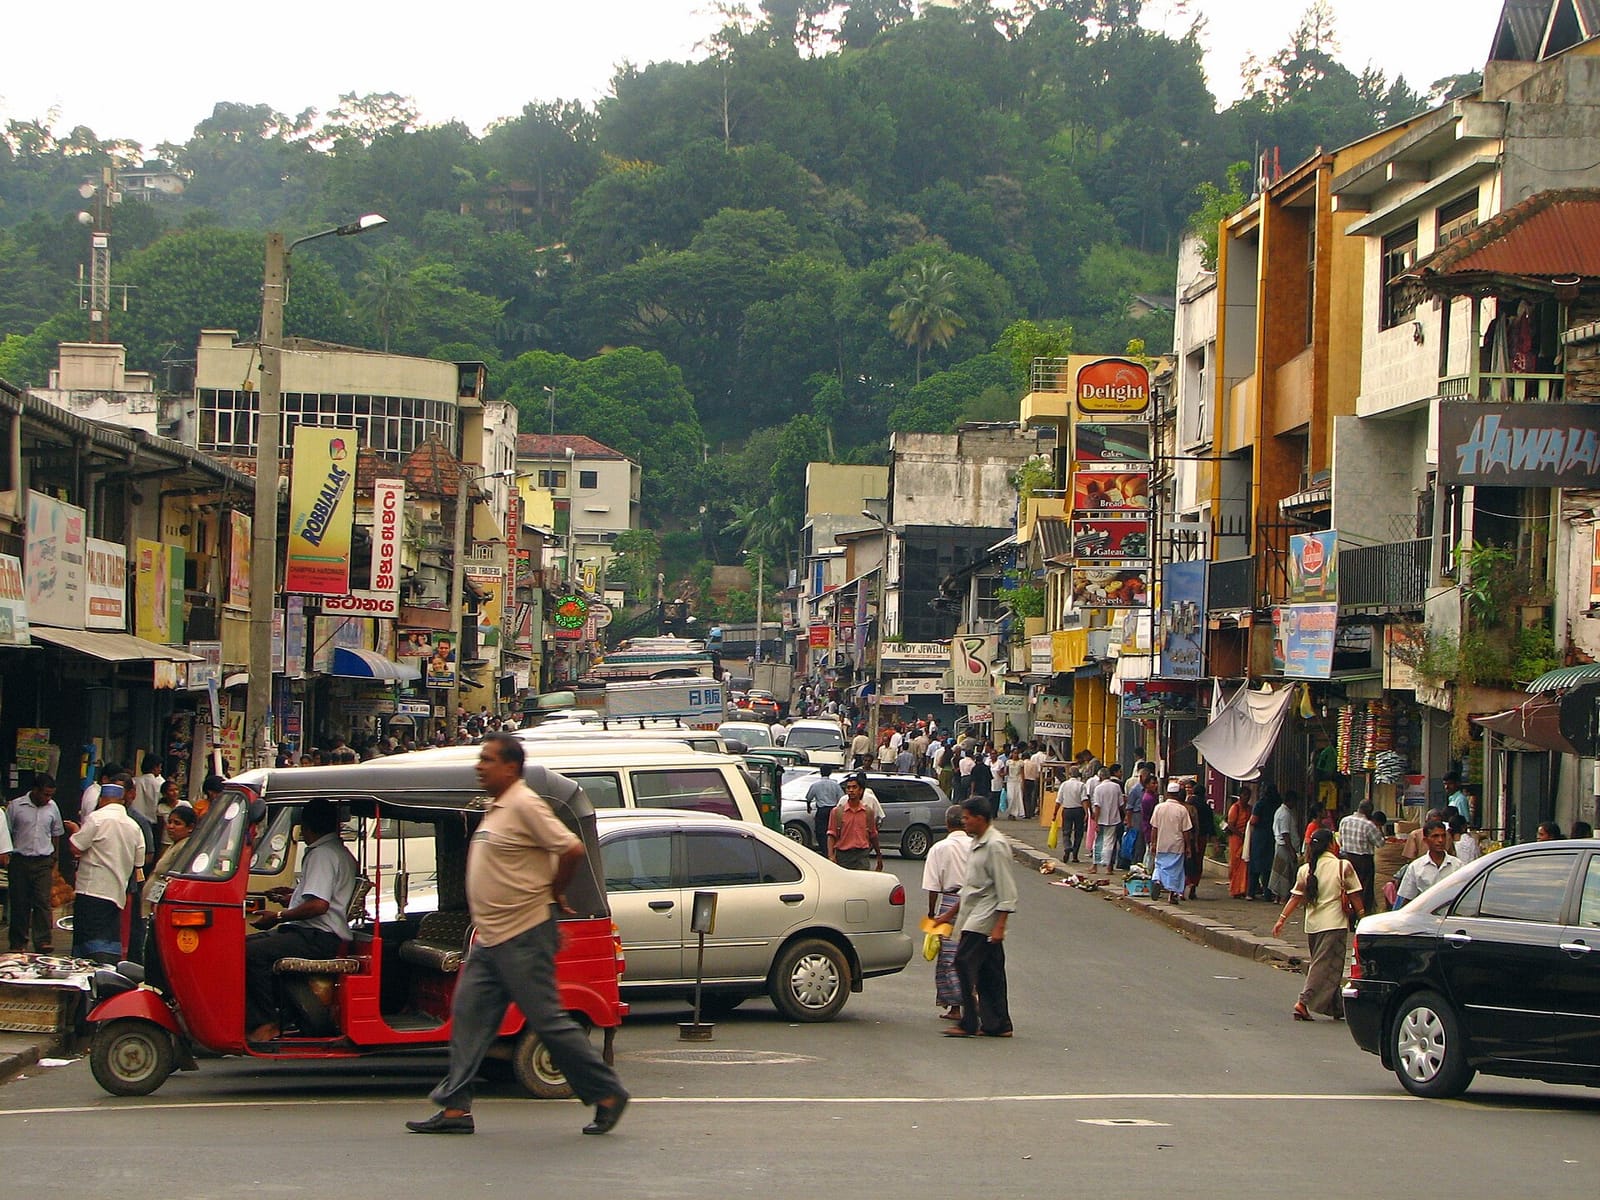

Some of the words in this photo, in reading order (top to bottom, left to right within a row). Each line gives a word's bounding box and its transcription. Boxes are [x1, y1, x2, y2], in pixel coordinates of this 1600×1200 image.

[1082, 383, 1144, 402] Delight
[1456, 414, 1600, 475] HAWAIA
[1101, 450, 1123, 458] Cakes
[301, 464, 347, 547] ROBBIALAC
[1096, 548, 1124, 556] Gateau
[892, 644, 916, 653] KANDY
